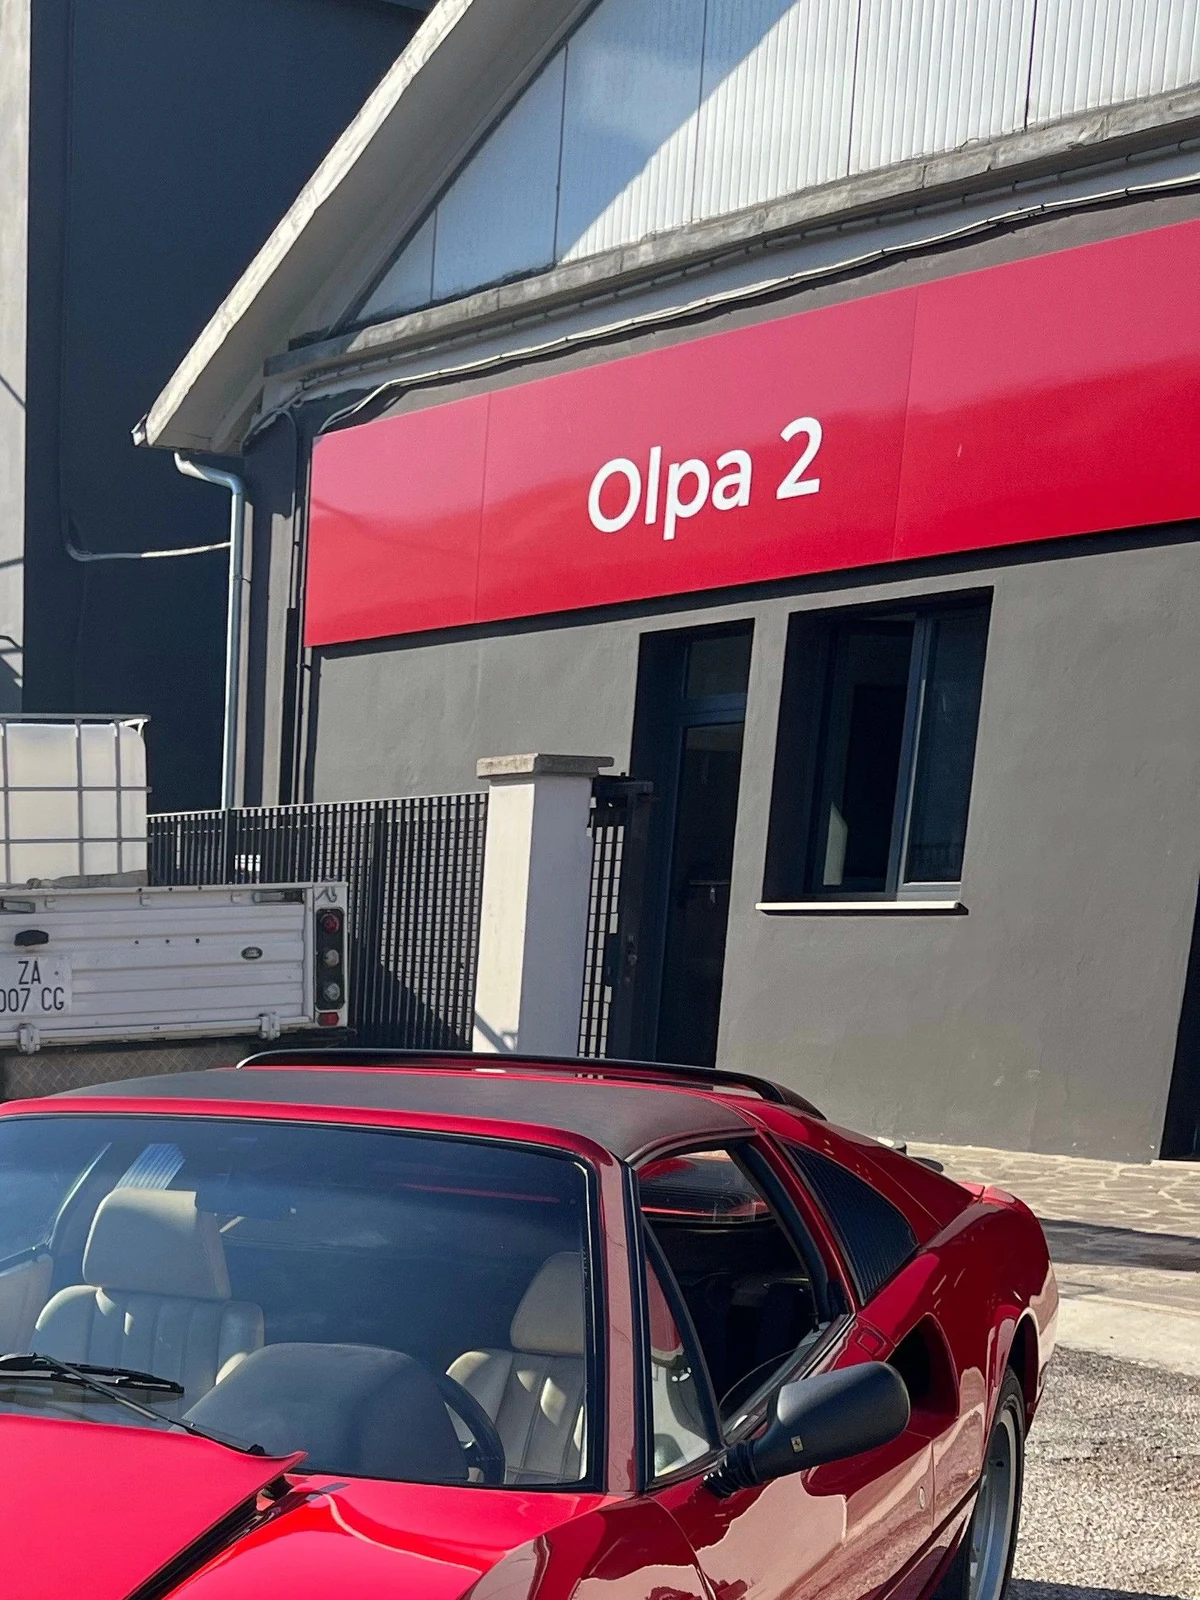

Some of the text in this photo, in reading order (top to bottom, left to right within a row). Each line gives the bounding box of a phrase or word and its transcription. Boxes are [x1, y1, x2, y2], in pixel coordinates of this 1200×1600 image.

[587, 416, 823, 541] Olpa 2
[17, 960, 42, 985] ZA
[41, 986, 65, 1011] CG
